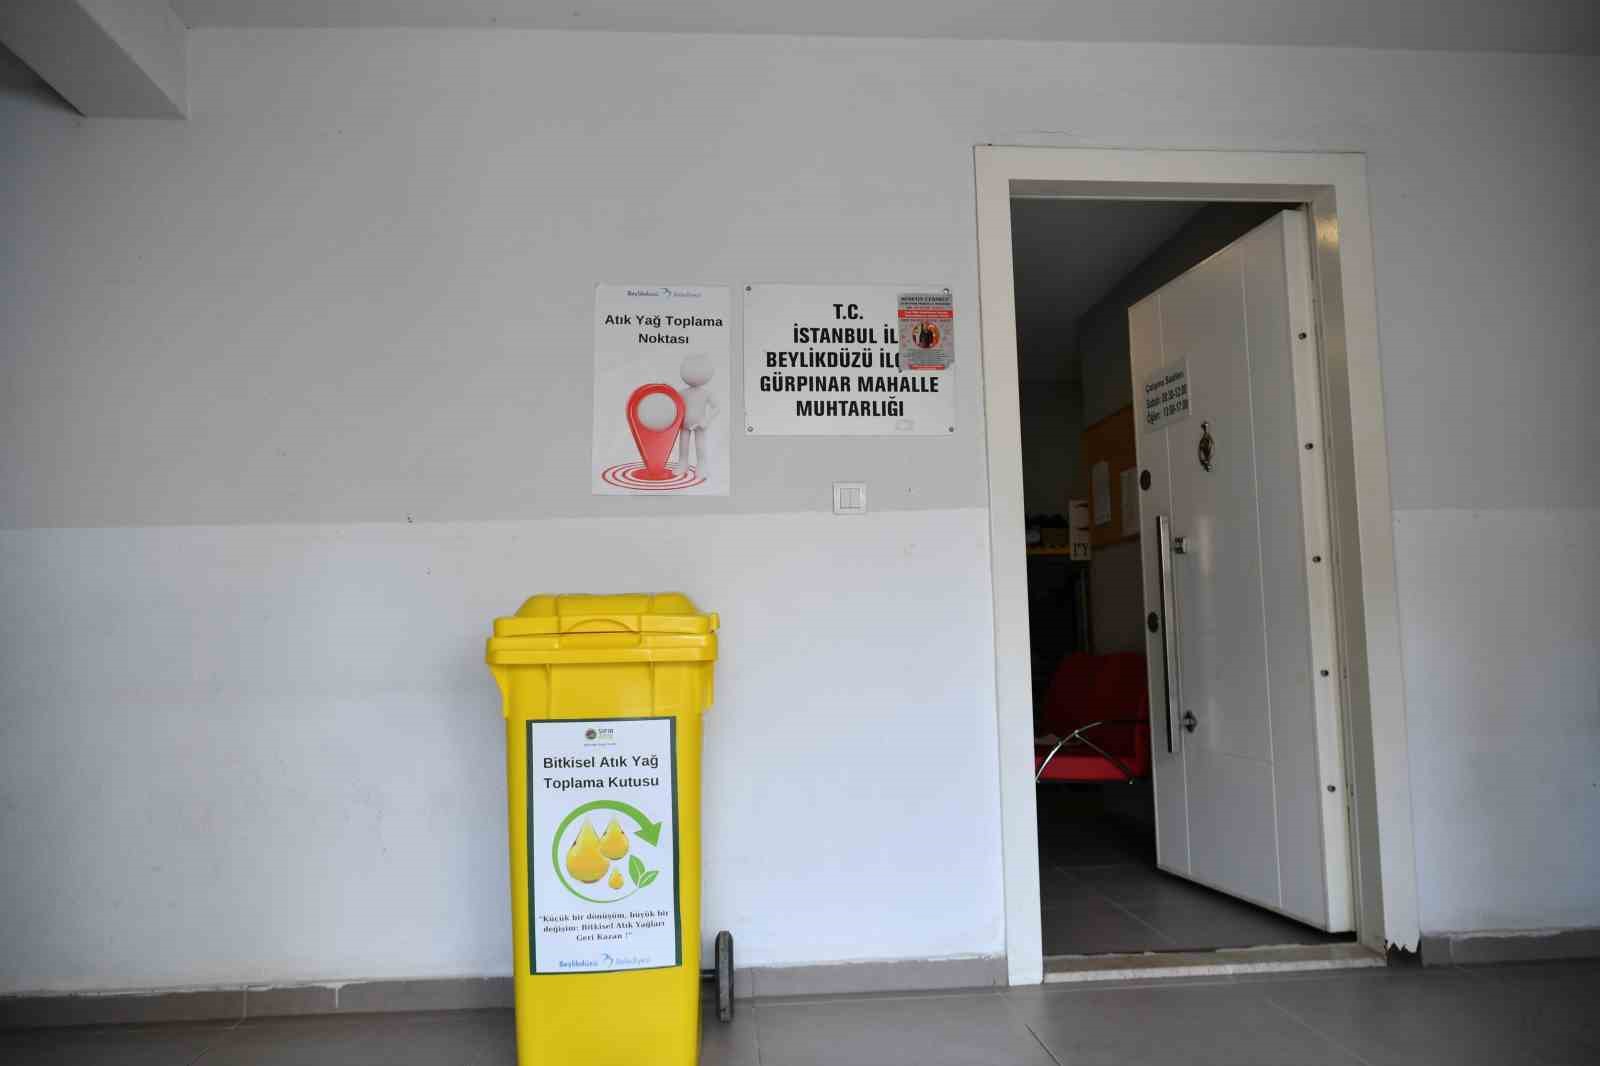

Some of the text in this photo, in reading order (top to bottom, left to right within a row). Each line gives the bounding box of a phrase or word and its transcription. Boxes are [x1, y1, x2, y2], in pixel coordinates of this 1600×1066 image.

[833, 303, 864, 320] T.C.
[605, 314, 723, 329] Atık Yağ Toplama
[638, 333, 690, 344] Noktası
[793, 323, 878, 344] İSTANBUL
[766, 347, 873, 368] BEYLİKDÜZÜ
[760, 371, 940, 393] GÜRPINAR MAHALLE
[796, 395, 904, 417] MUHTARLIĞI
[543, 754, 659, 770] Bitkisel Atık Yağ
[544, 775, 660, 792] Toplama Kutusu
[581, 923, 614, 931] Bitkisel
[616, 922, 633, 930] Atık
[597, 933, 623, 941] Kazan
